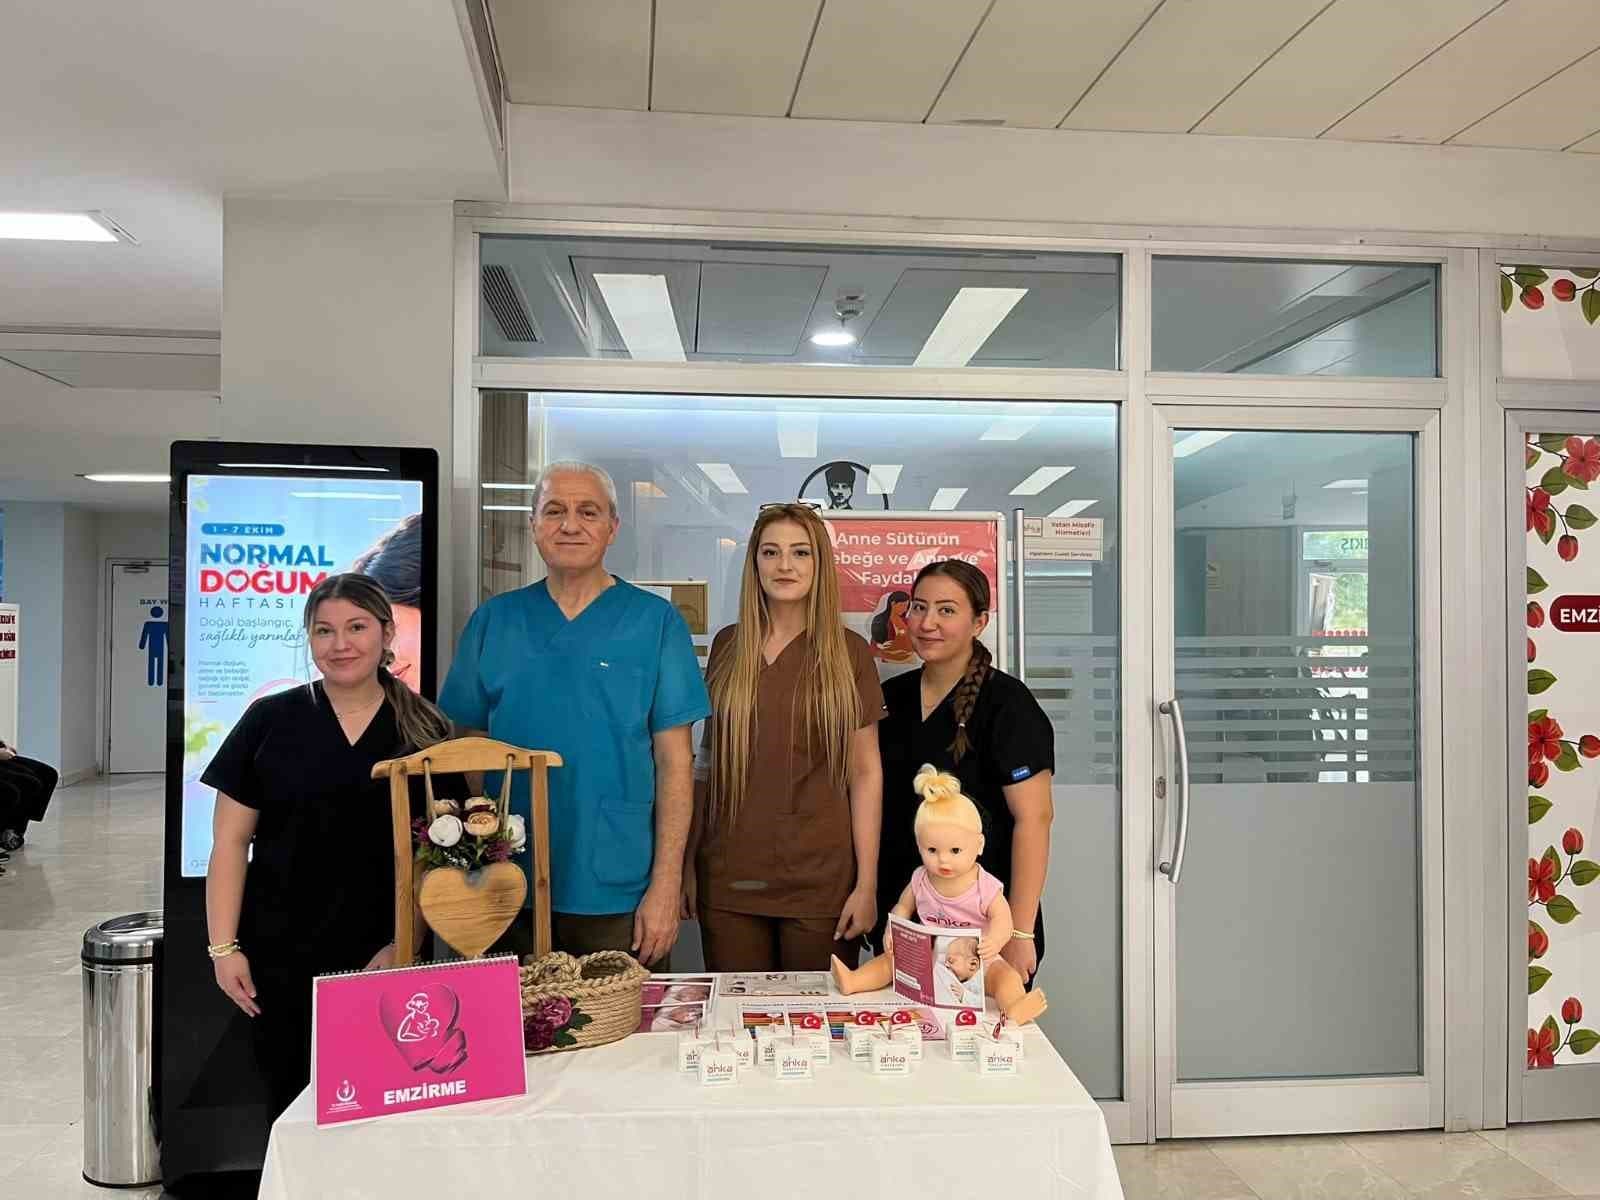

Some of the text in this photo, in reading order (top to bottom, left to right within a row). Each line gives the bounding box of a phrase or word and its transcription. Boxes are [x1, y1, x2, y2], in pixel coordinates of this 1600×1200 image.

[836, 532, 960, 545] Anne Sütünün
[200, 543, 334, 567] NORMAL
[834, 551, 884, 568] ebeğe
[888, 554, 909, 565] ve
[200, 563, 328, 595] DOĞUM
[862, 571, 918, 587] Faydal
[199, 597, 294, 609] HAFTASI
[200, 616, 294, 628] Doğal başlangıç,
[1560, 606, 1600, 623] EMZ
[200, 628, 247, 648] sağlıklı
[383, 1080, 467, 1105] EMZİRME
